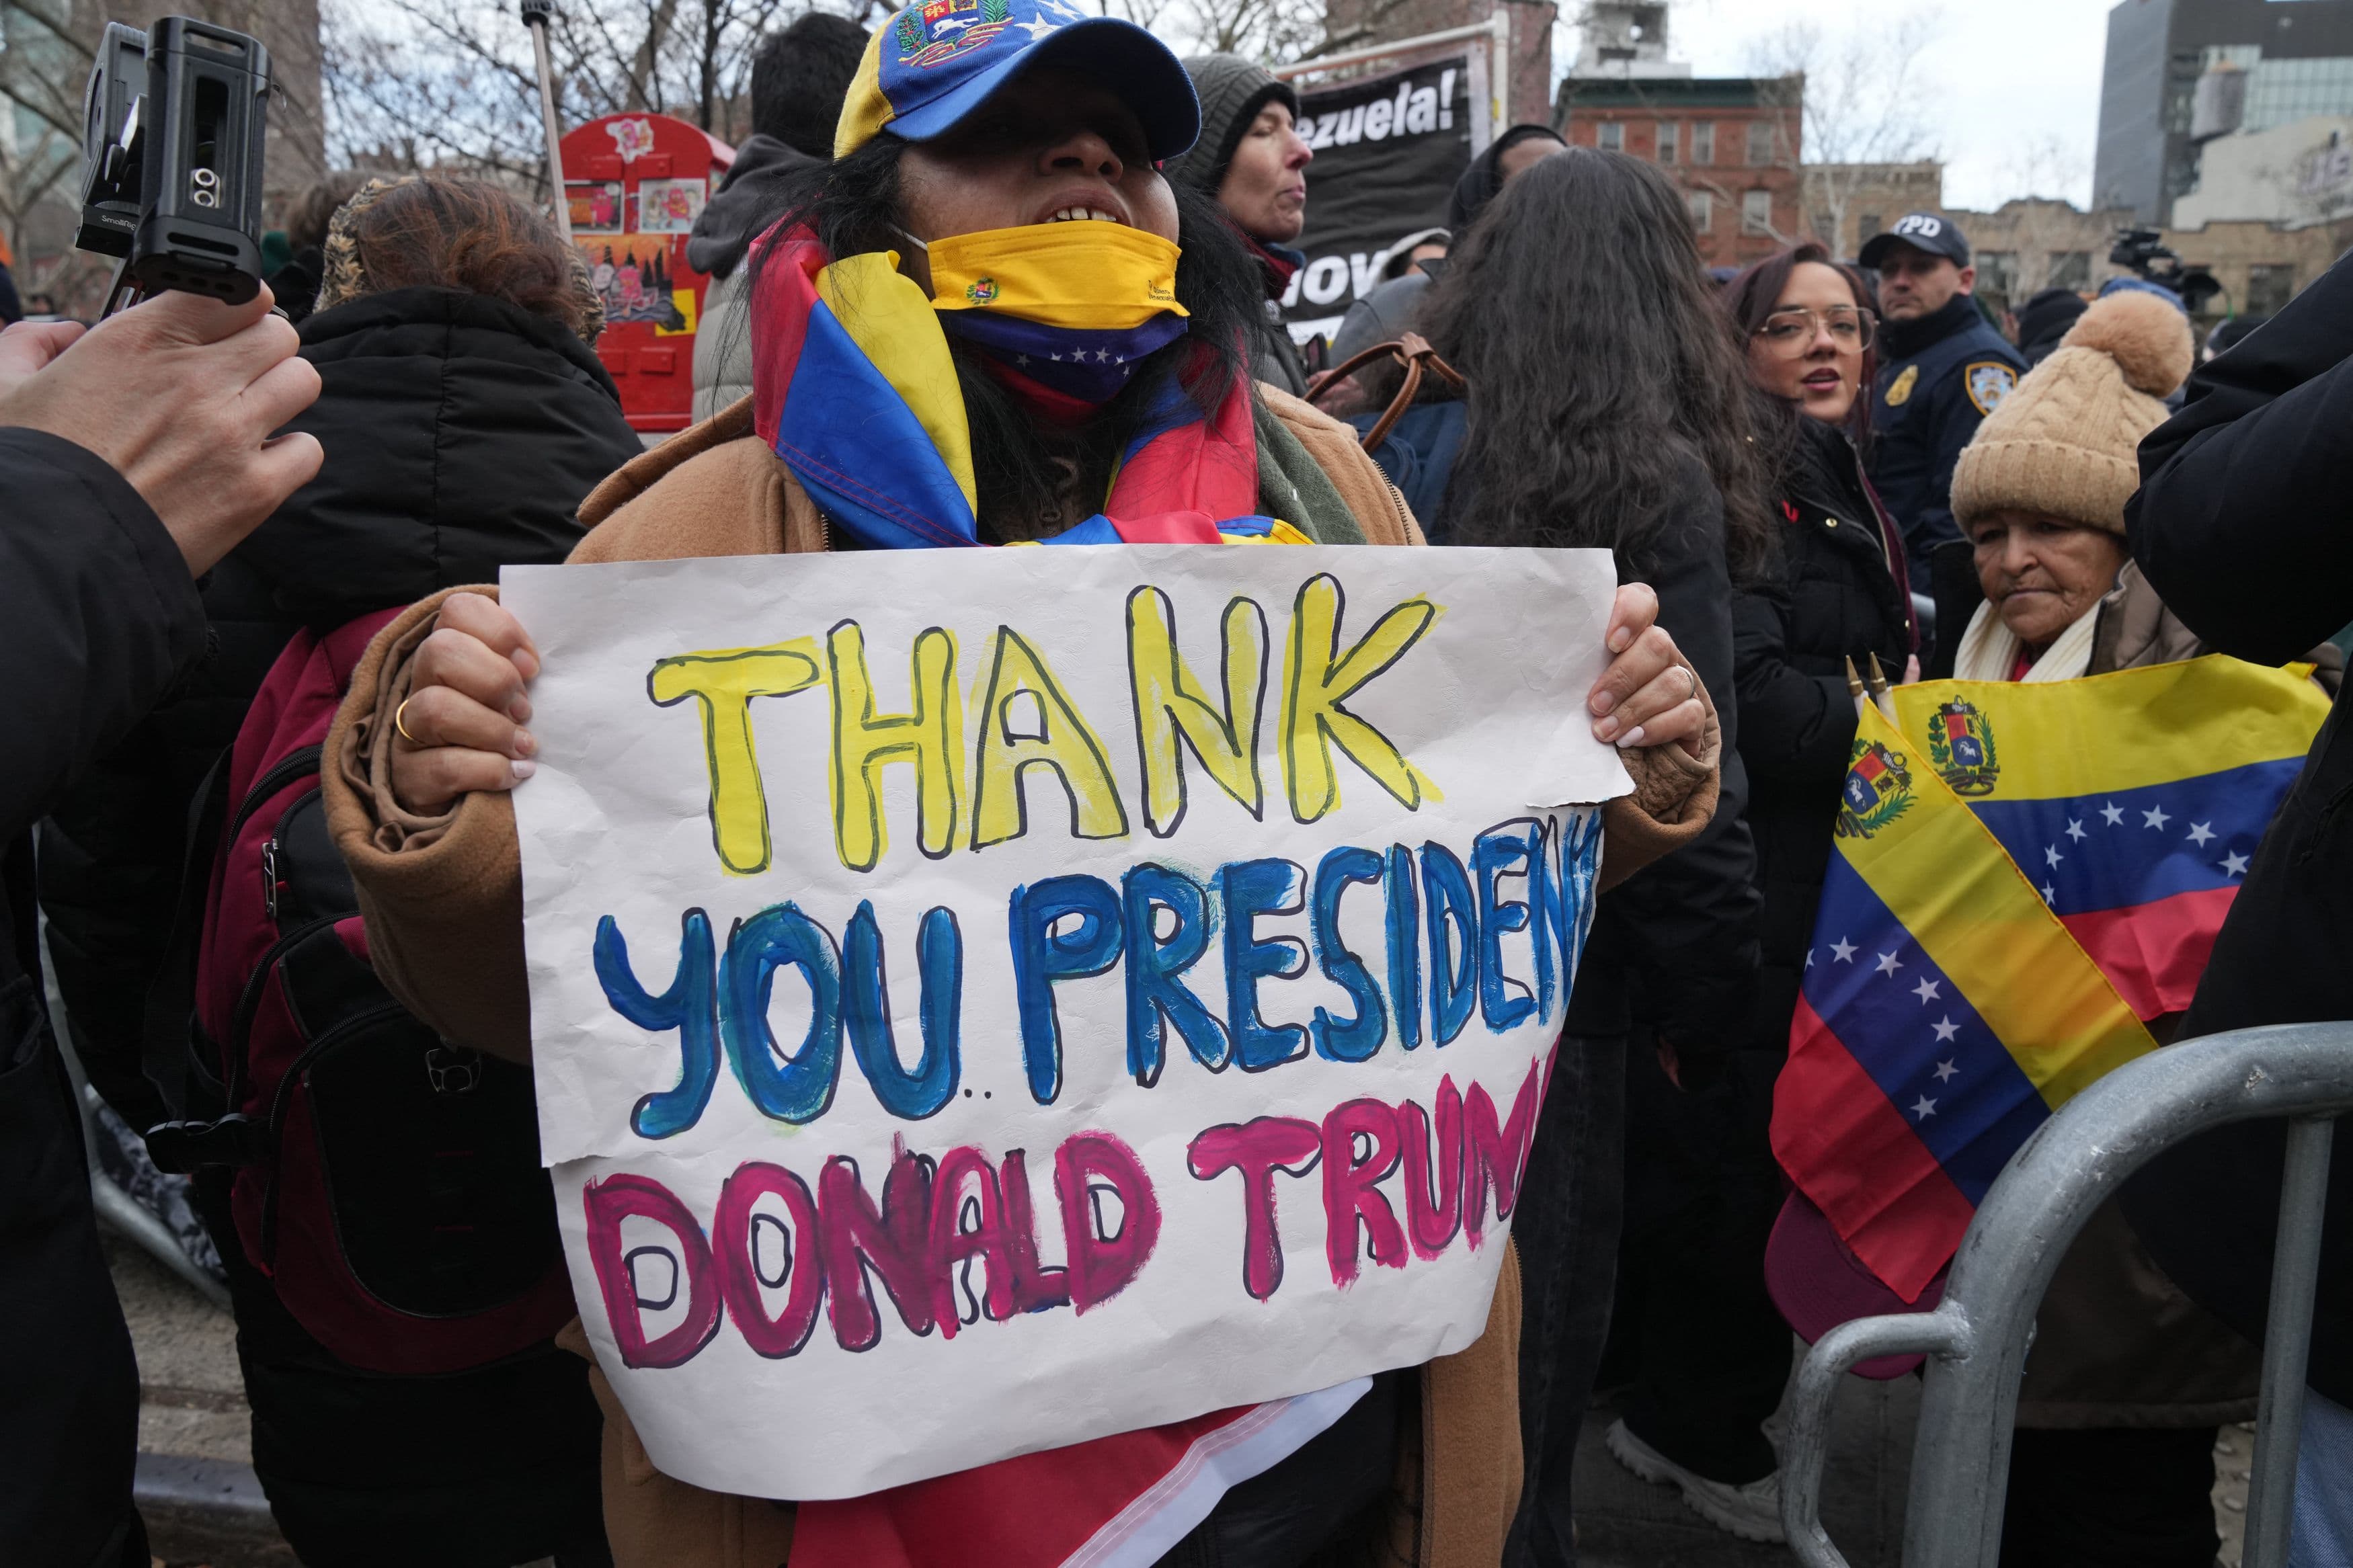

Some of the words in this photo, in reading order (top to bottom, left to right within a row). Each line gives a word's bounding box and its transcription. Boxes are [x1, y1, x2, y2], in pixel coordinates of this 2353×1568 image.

[1295, 69, 1456, 150] ezuela!
[646, 573, 1448, 876] THANK
[583, 1129, 1162, 1369] DONALD
[1187, 1030, 1562, 1304] TRUM
